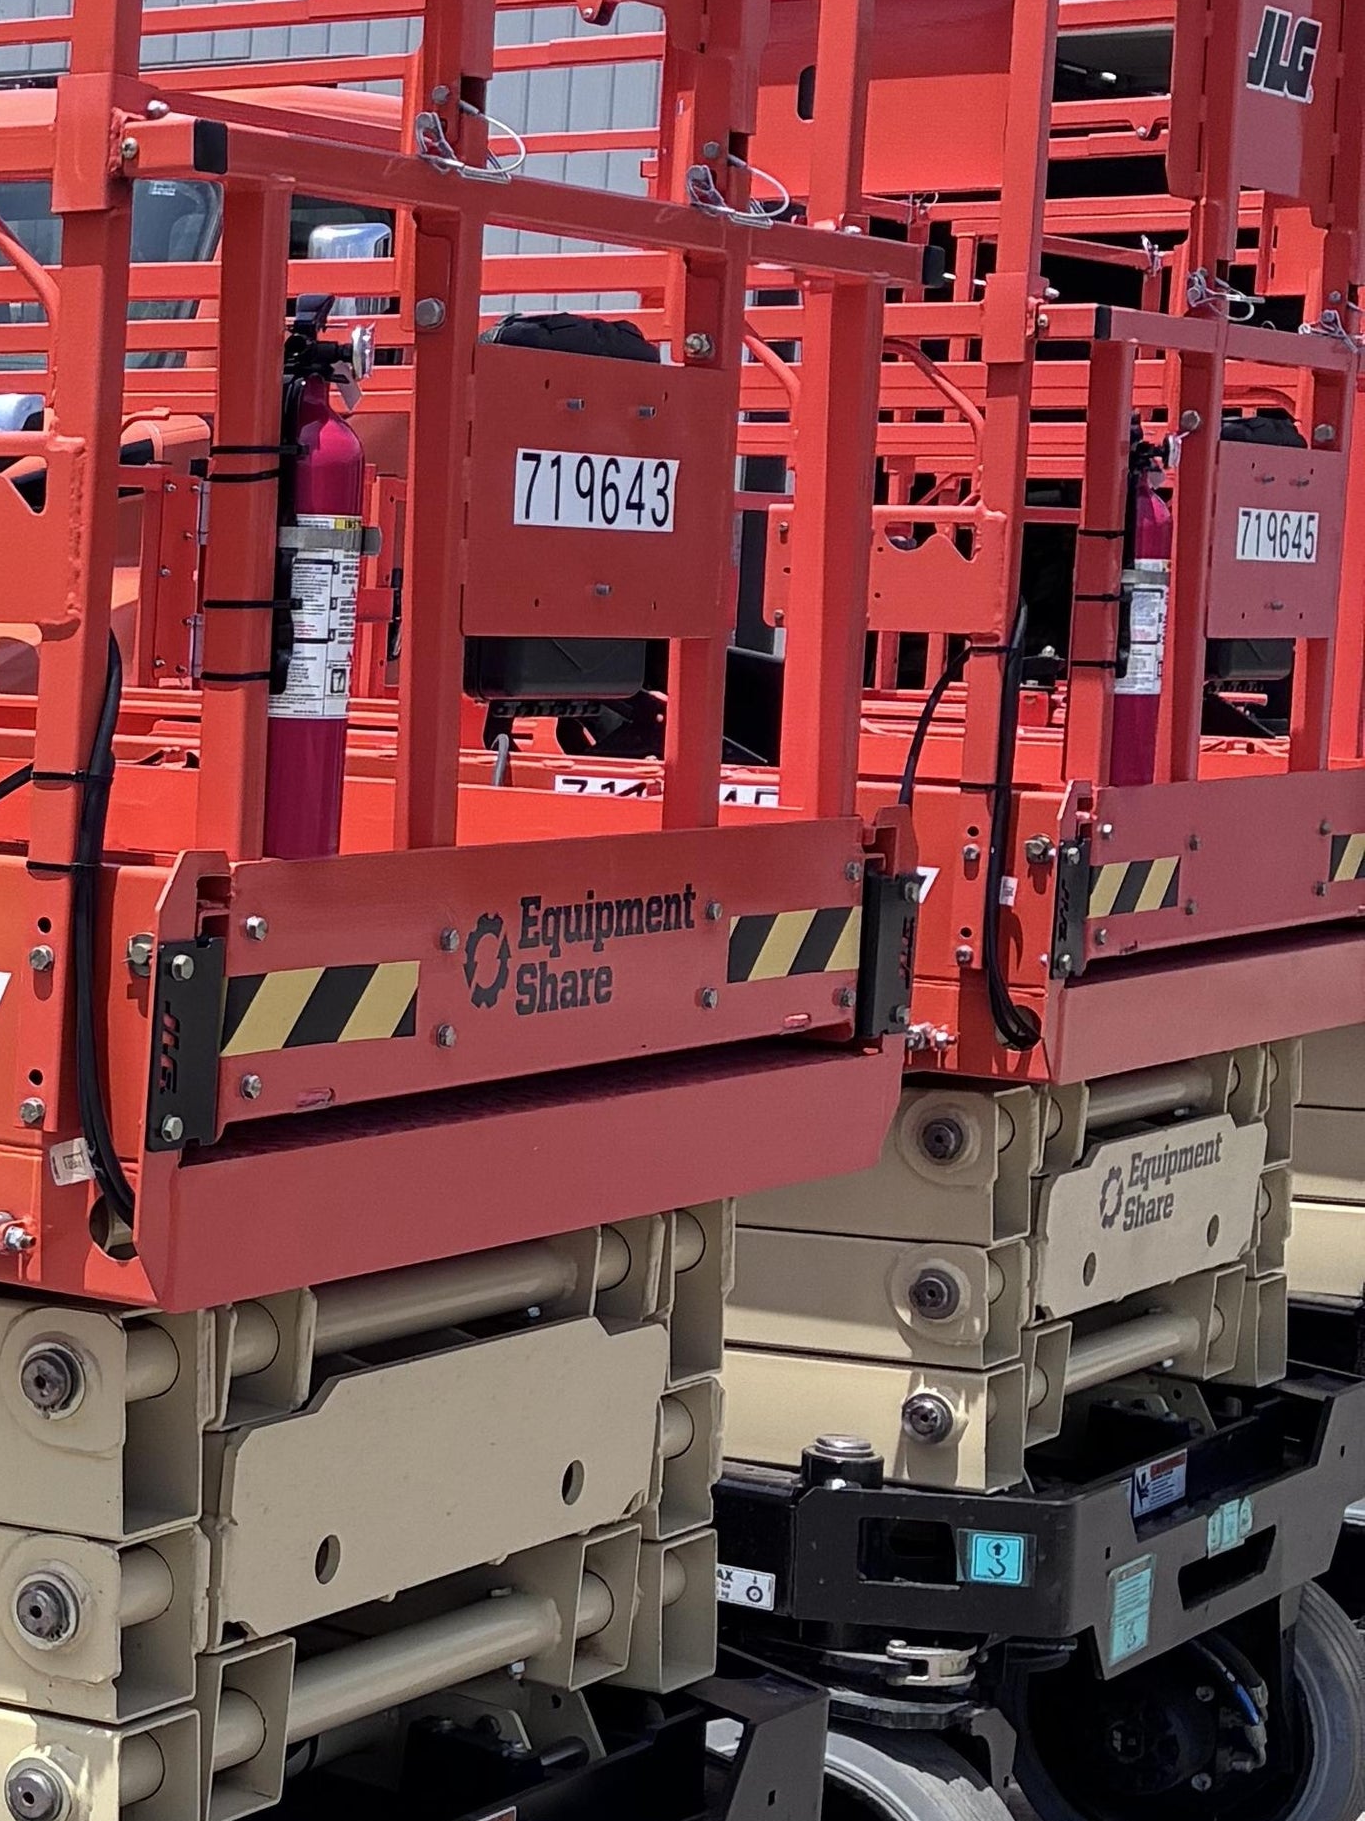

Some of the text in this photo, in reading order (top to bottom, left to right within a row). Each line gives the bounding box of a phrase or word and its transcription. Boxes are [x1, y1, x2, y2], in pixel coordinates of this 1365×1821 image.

[1246, 5, 1322, 104] JLG
[522, 452, 670, 527] 719643
[1241, 510, 1316, 559] 719645
[518, 883, 697, 958] Equipment
[515, 960, 614, 1016] Share
[1128, 1132, 1223, 1192] Equipment
[1122, 1192, 1175, 1232] Share
